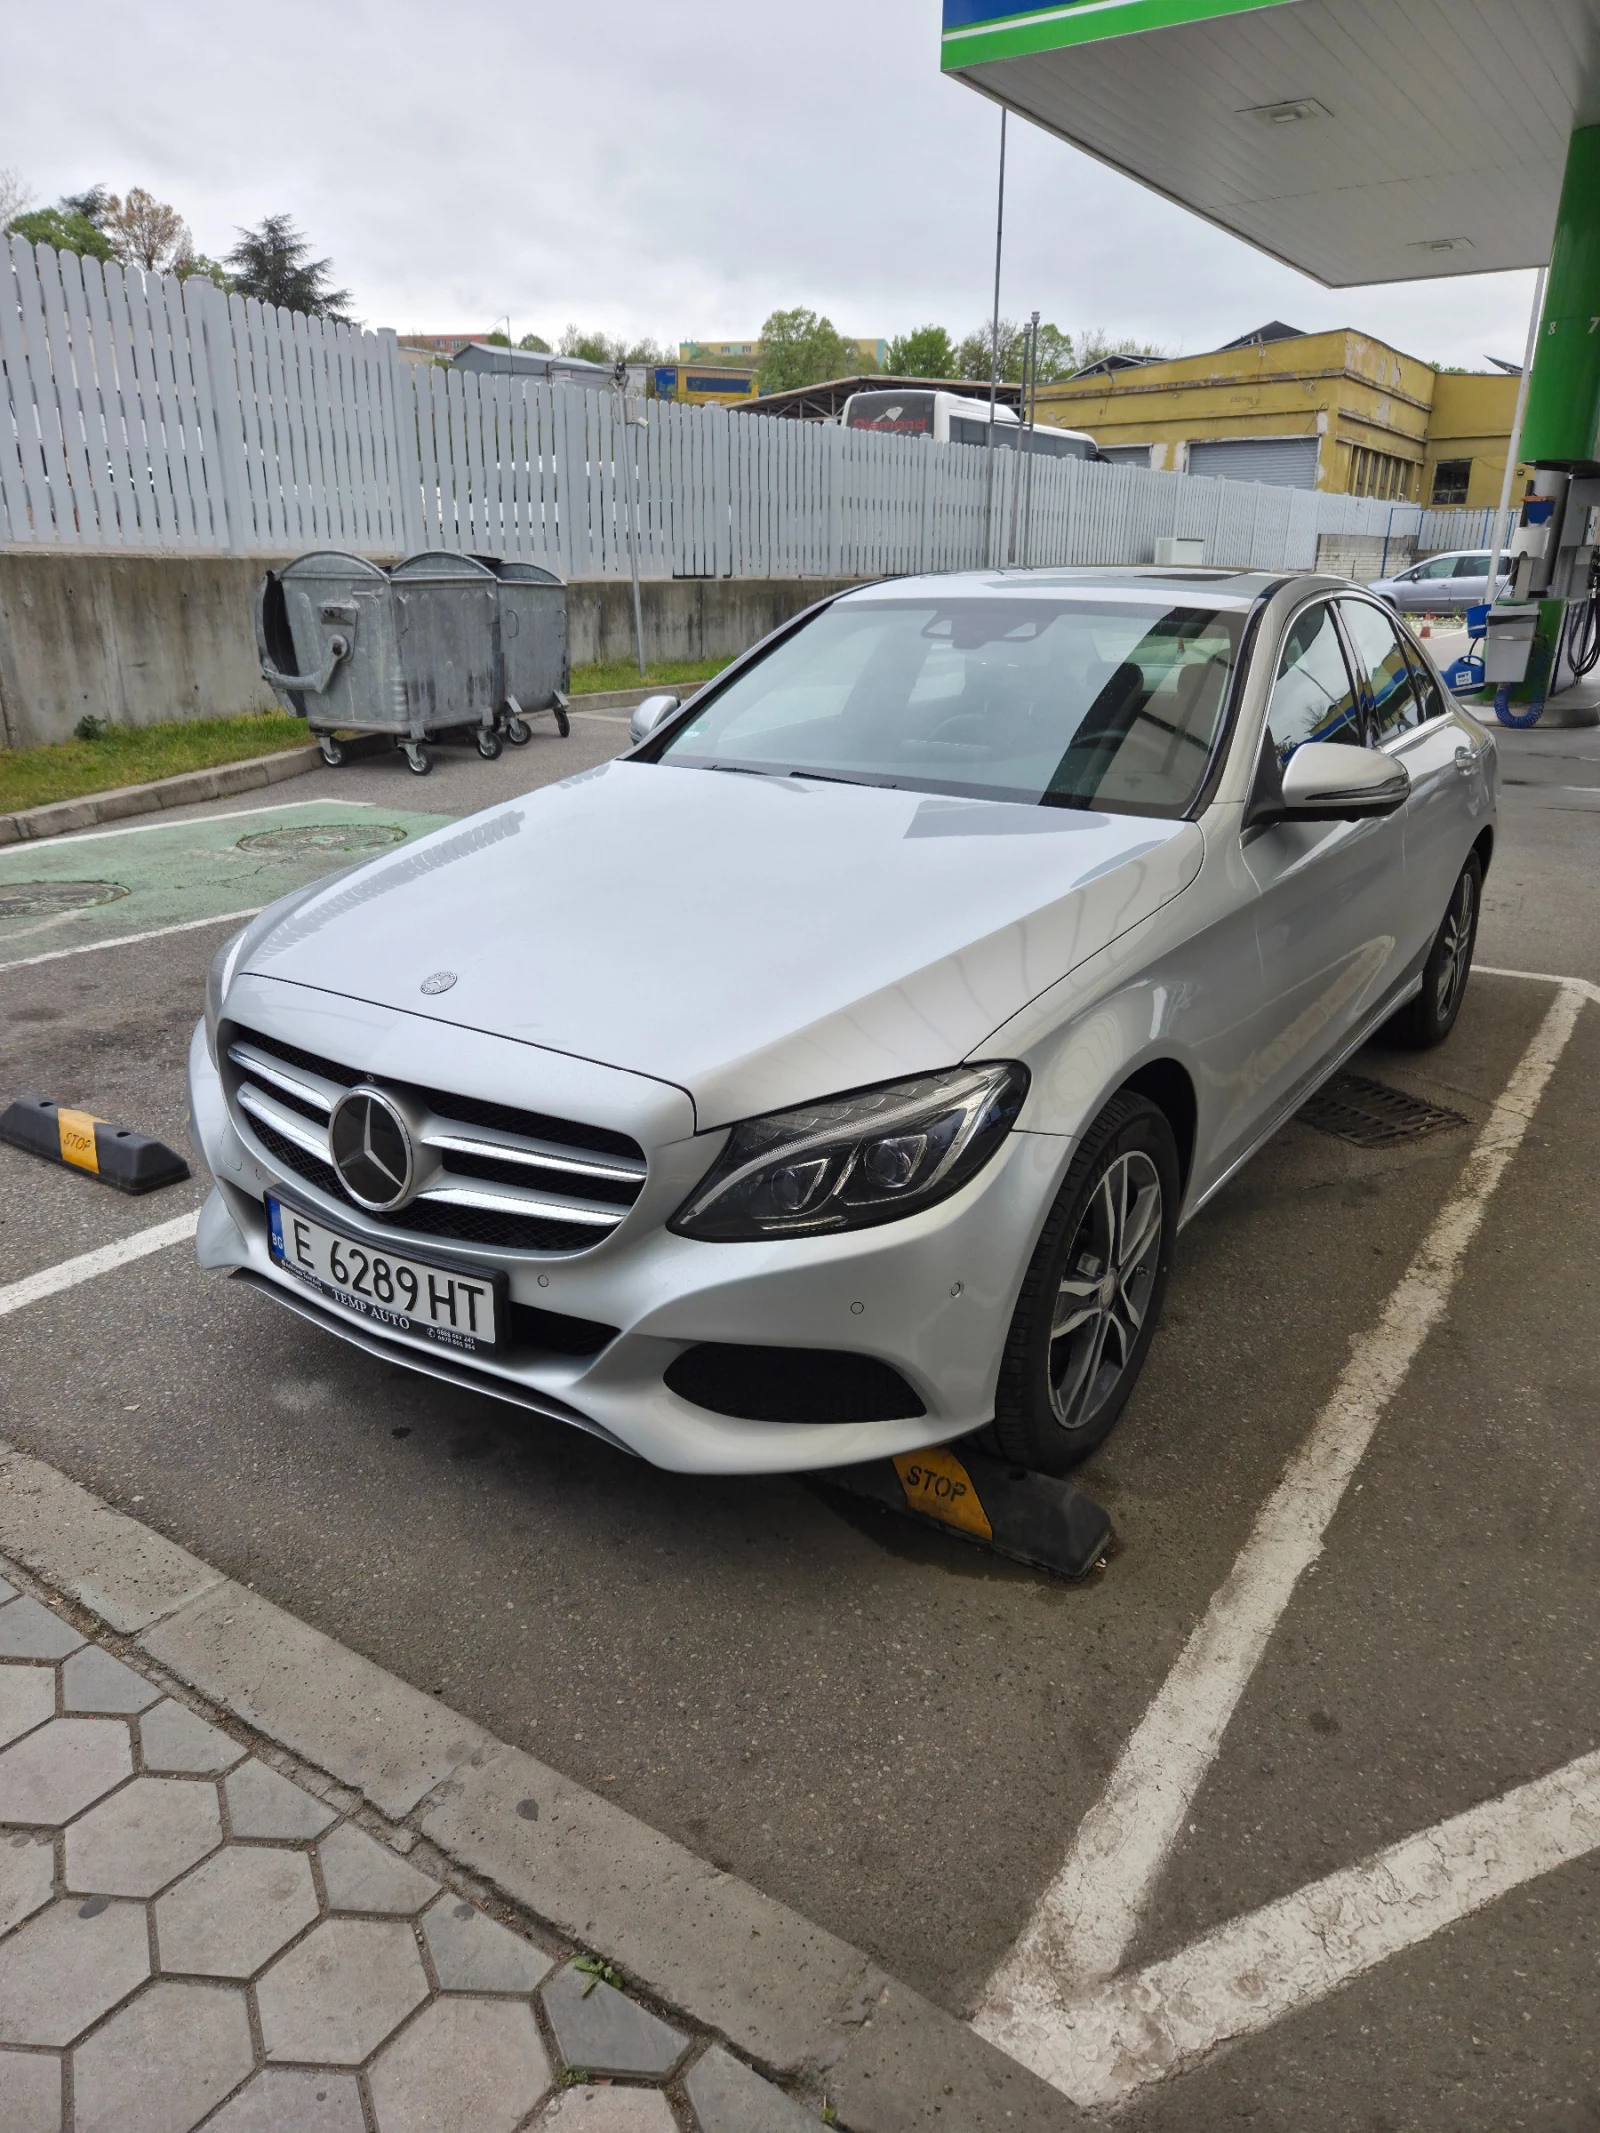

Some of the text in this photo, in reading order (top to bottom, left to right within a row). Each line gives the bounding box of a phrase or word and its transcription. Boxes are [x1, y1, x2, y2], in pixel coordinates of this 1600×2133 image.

[1548, 321, 1557, 336] 8
[1587, 316, 1600, 334] 7
[63, 1132, 91, 1151] STOP
[271, 1232, 284, 1250] BG
[293, 1218, 314, 1269] E
[330, 1240, 419, 1312] 6289
[428, 1274, 485, 1332] HT
[331, 1288, 410, 1330] TEMP AUTO
[906, 1465, 967, 1501] STOP
